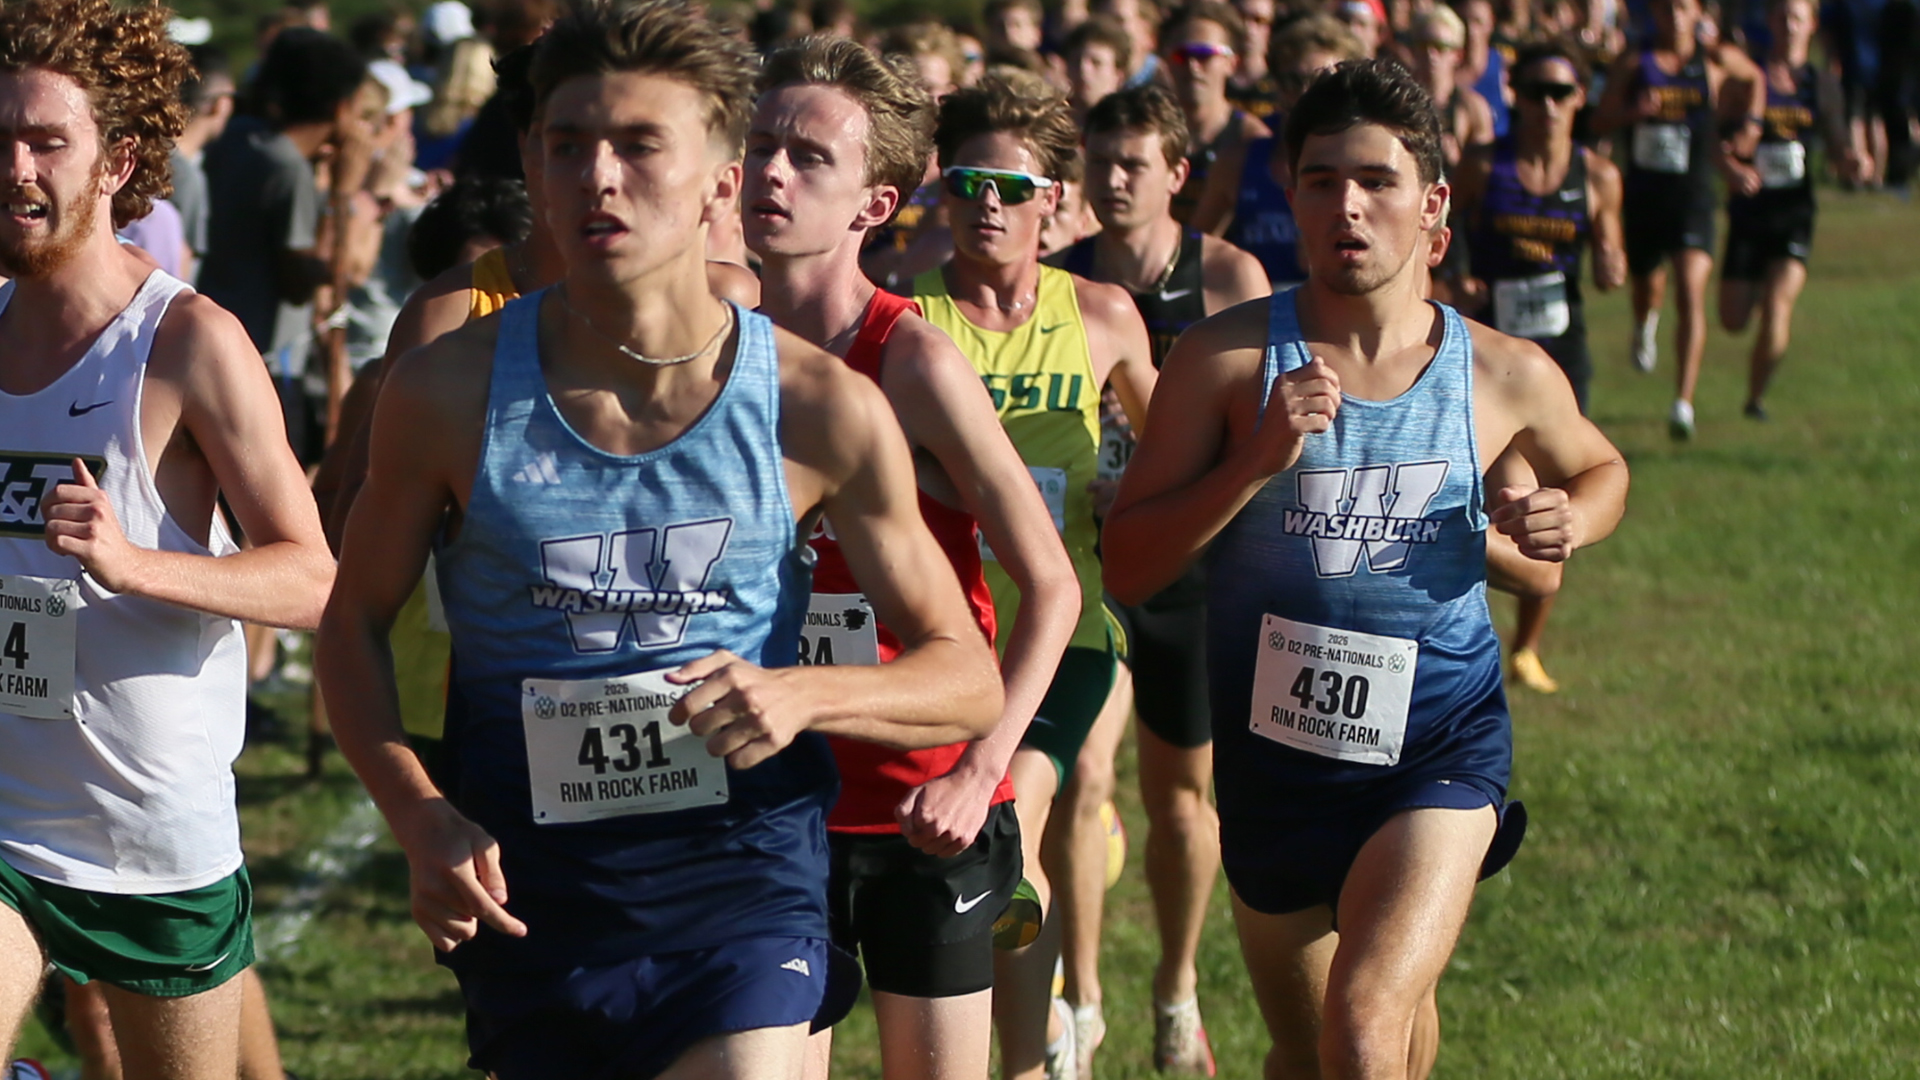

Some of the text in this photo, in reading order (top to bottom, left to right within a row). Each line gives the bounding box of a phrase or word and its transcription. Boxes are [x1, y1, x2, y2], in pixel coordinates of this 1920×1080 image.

[0, 463, 74, 524] &T
[1283, 508, 1442, 542] WASHBURN
[528, 583, 731, 616] WASHBURN
[0, 622, 29, 670] 4
[1288, 640, 1384, 668] D2 PRE-NATIONALS
[1327, 634, 1349, 646] 2026
[7, 673, 48, 698] FARM
[604, 683, 629, 696] 2026
[1290, 666, 1369, 720] 430
[561, 692, 677, 717] D2 PRE-NATIONALS
[1271, 705, 1296, 729] RIM
[1297, 714, 1337, 739] ROCK
[1338, 723, 1381, 746] FARM
[578, 721, 671, 774] 431
[560, 767, 698, 803] RIM ROCK FARM
